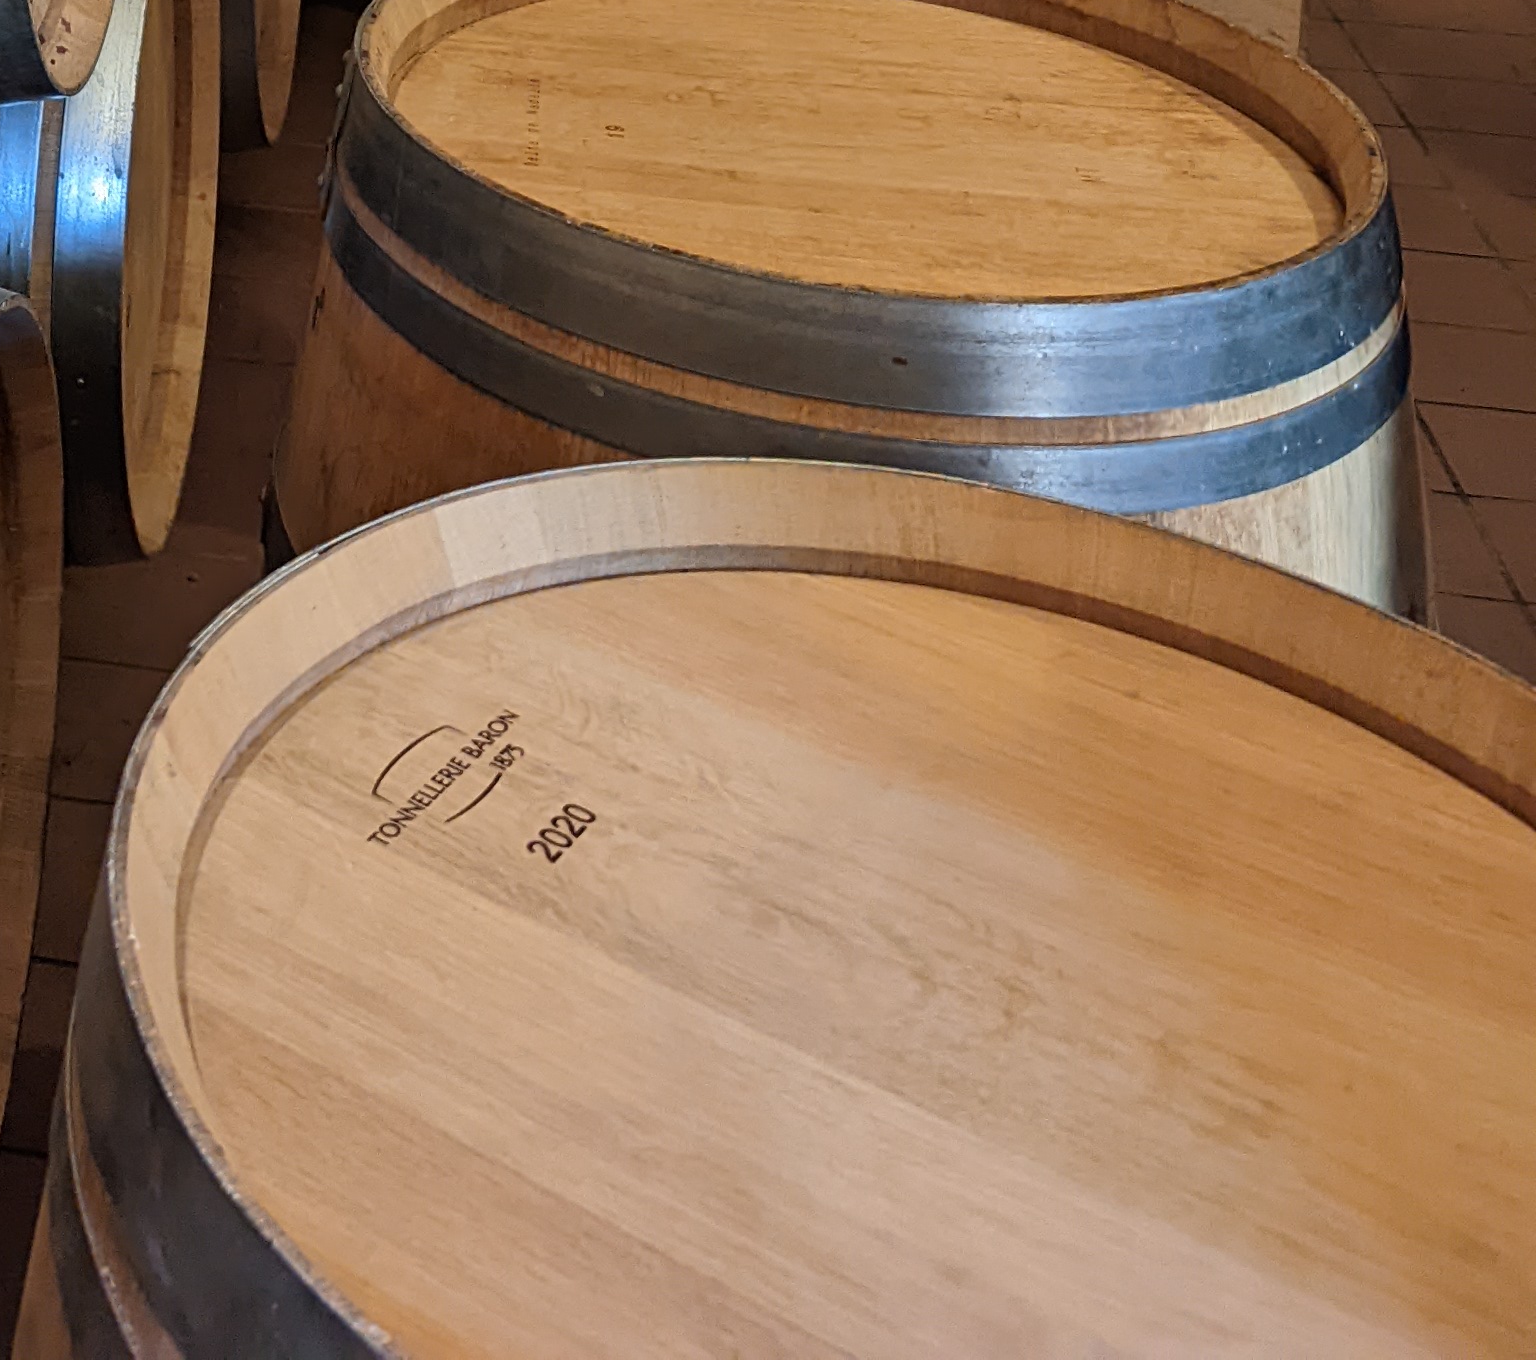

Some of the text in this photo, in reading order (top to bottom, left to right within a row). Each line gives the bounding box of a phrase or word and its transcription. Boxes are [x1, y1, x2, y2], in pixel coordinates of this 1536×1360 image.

[367, 708, 520, 846] TONNELLERIE BARON
[489, 743, 525, 771] 1875
[526, 803, 597, 864] 2020
